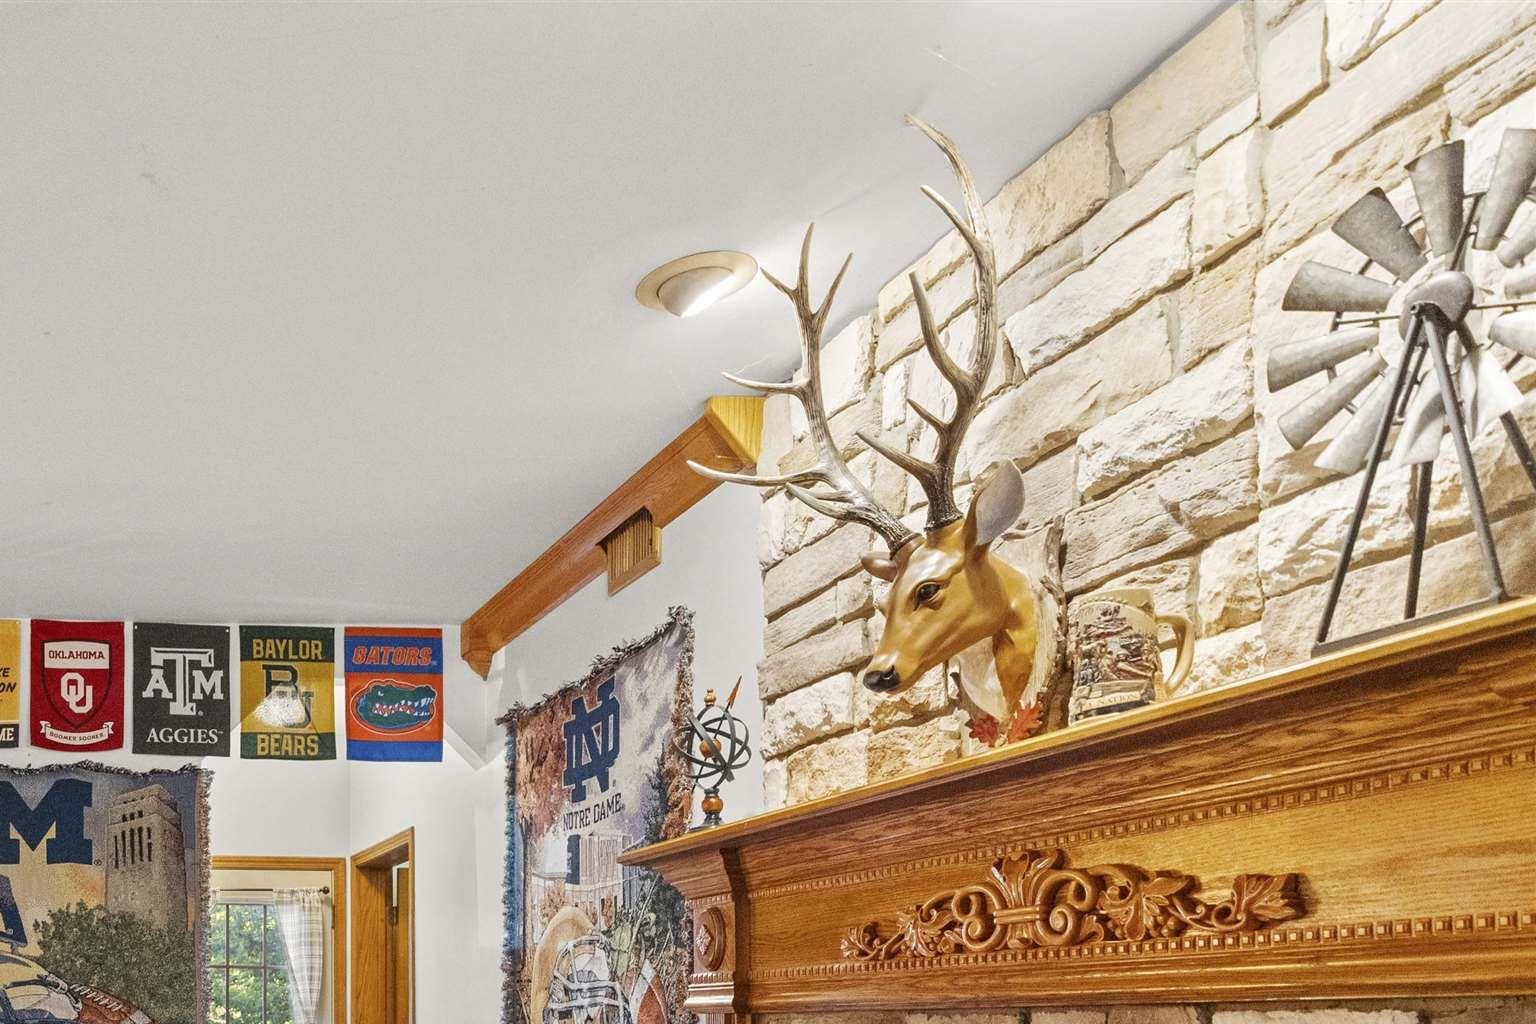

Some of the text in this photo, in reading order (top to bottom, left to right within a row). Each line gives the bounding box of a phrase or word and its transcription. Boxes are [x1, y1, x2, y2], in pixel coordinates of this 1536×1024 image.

[48, 650, 106, 660] OKLAHOMA
[252, 639, 323, 660] BAYLOR
[352, 646, 433, 666] GATORS
[60, 672, 93, 714] OU
[146, 727, 219, 744] AGGIES
[256, 735, 320, 756] BEARS
[563, 793, 622, 831] NOTRE DAME
